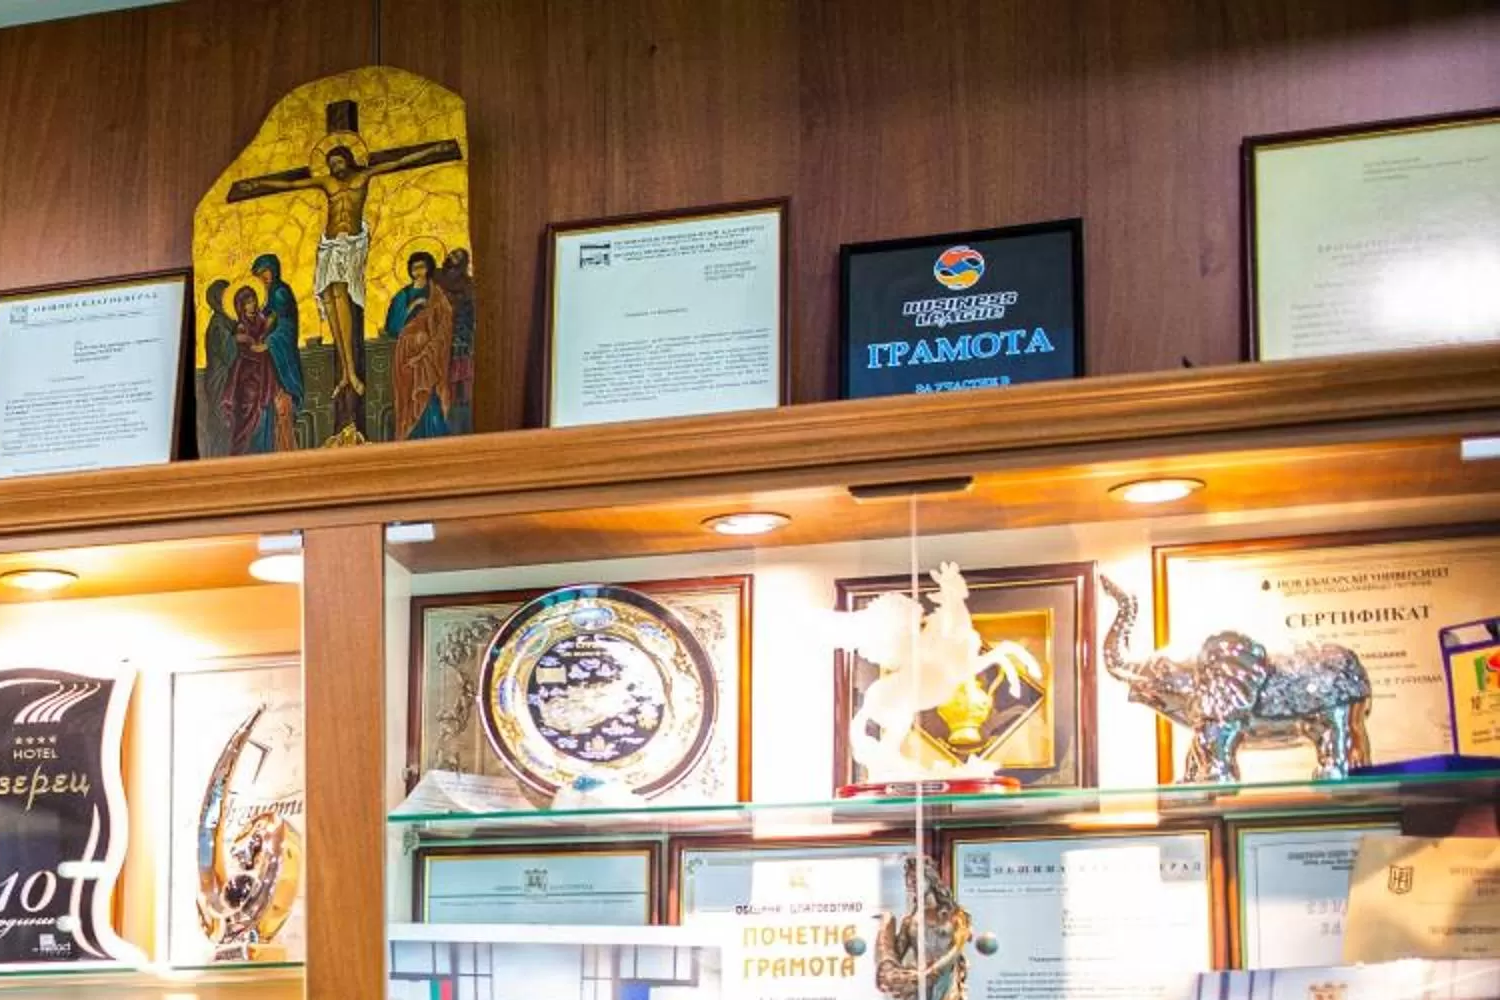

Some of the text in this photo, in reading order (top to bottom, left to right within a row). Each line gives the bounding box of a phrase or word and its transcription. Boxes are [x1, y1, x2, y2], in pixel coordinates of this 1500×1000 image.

[902, 291, 1019, 315] BUSINESS
[866, 327, 1056, 369] ГРАМОТА
[1285, 605, 1433, 628] СЕРТИФИКАТ
[13, 748, 60, 759] HOTEL
[743, 956, 856, 979] ГРАМОТА
